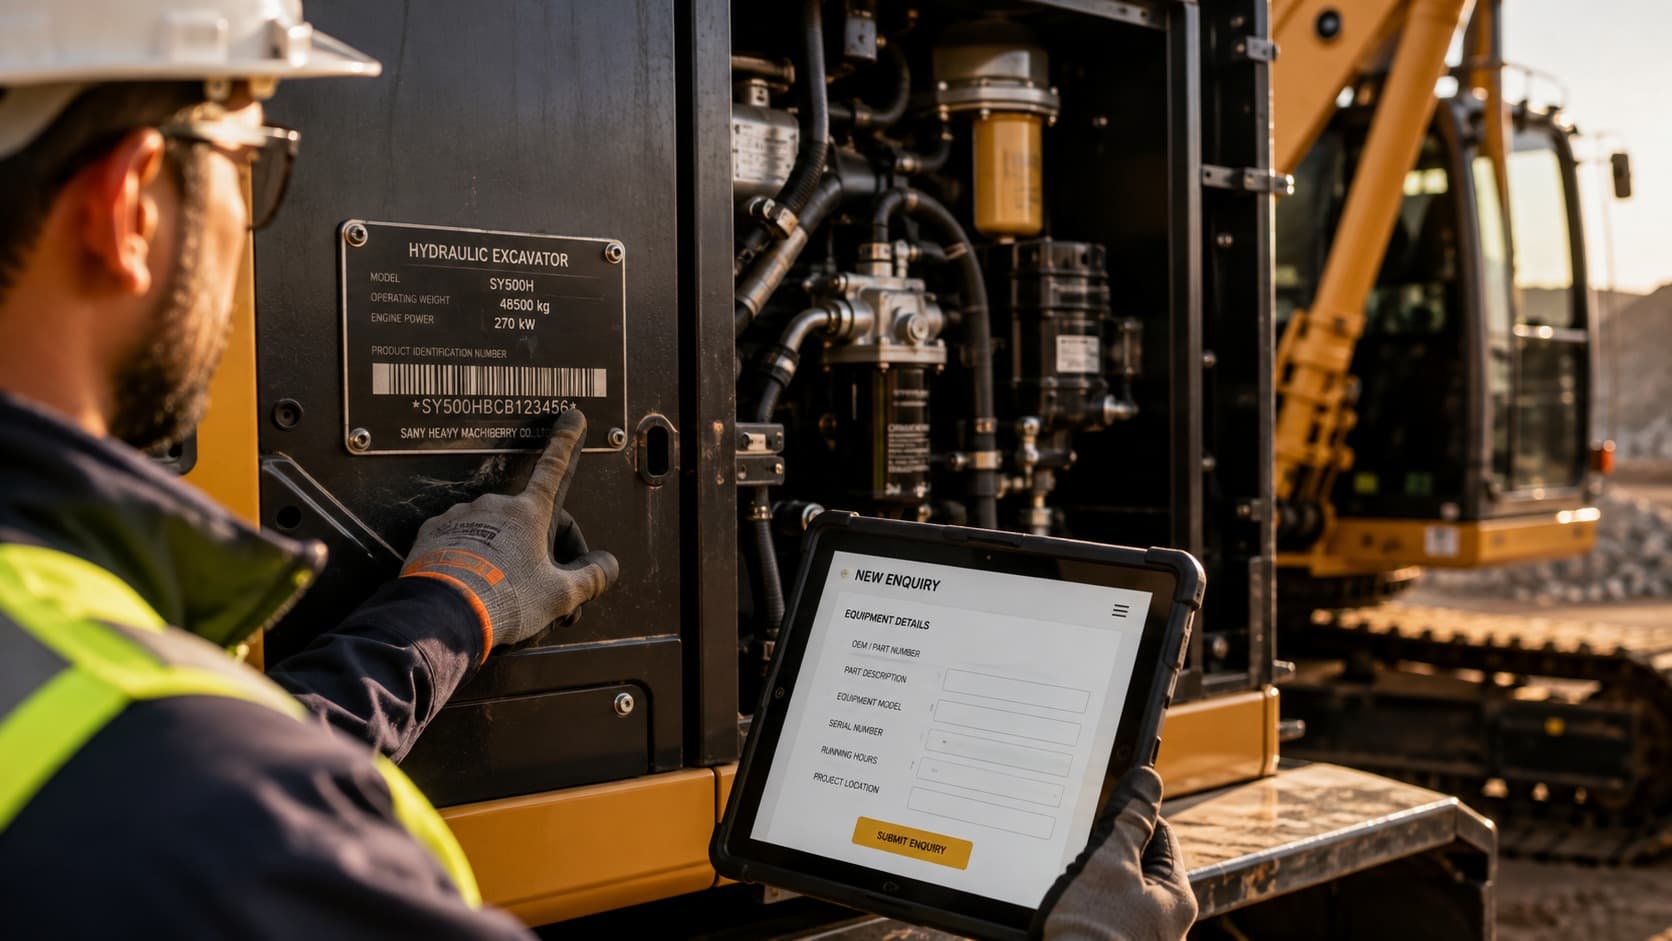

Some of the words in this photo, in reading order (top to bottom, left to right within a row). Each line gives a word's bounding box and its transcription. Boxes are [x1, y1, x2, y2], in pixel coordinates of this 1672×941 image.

[409, 242, 488, 262] HYDRAULIC
[492, 248, 569, 268] EXCAVATOR
[370, 272, 400, 283] MODEL
[489, 278, 534, 292] SY500H
[370, 293, 417, 305] OPERATING
[419, 294, 450, 305] WEIGHT
[500, 298, 534, 312] 48500
[537, 300, 550, 315] kg
[371, 313, 402, 324] ENGINE
[404, 314, 434, 325] POWER
[494, 317, 515, 330] 270
[519, 318, 536, 331] kW
[371, 345, 410, 357] PRODUCT
[413, 346, 473, 358] IDENTIFICATION
[474, 348, 507, 359] NUMBER
[400, 427, 425, 439] SANY
[428, 427, 459, 439] HEAVY
[855, 569, 883, 585] NEW
[886, 573, 941, 592] ENQUIRY
[844, 609, 894, 625] EQUIPMENT
[895, 616, 930, 630] DETAILS
[851, 639, 868, 650] OEM
[872, 643, 890, 653] PART
[890, 646, 921, 658] NUMBER
[844, 666, 862, 676] PART
[862, 668, 907, 684] DESCRIPTION
[836, 692, 877, 707] EQUIPMENT
[877, 699, 902, 711] MODEL
[828, 719, 852, 732] SERIAL
[853, 723, 884, 738] NUMBER
[821, 745, 852, 760] RUNNING
[853, 752, 878, 765] HOURS
[813, 772, 844, 787] PROJECT
[844, 778, 879, 795] LOCATION
[876, 830, 907, 846] SUBMIT
[908, 836, 947, 856] ENQUIRY
